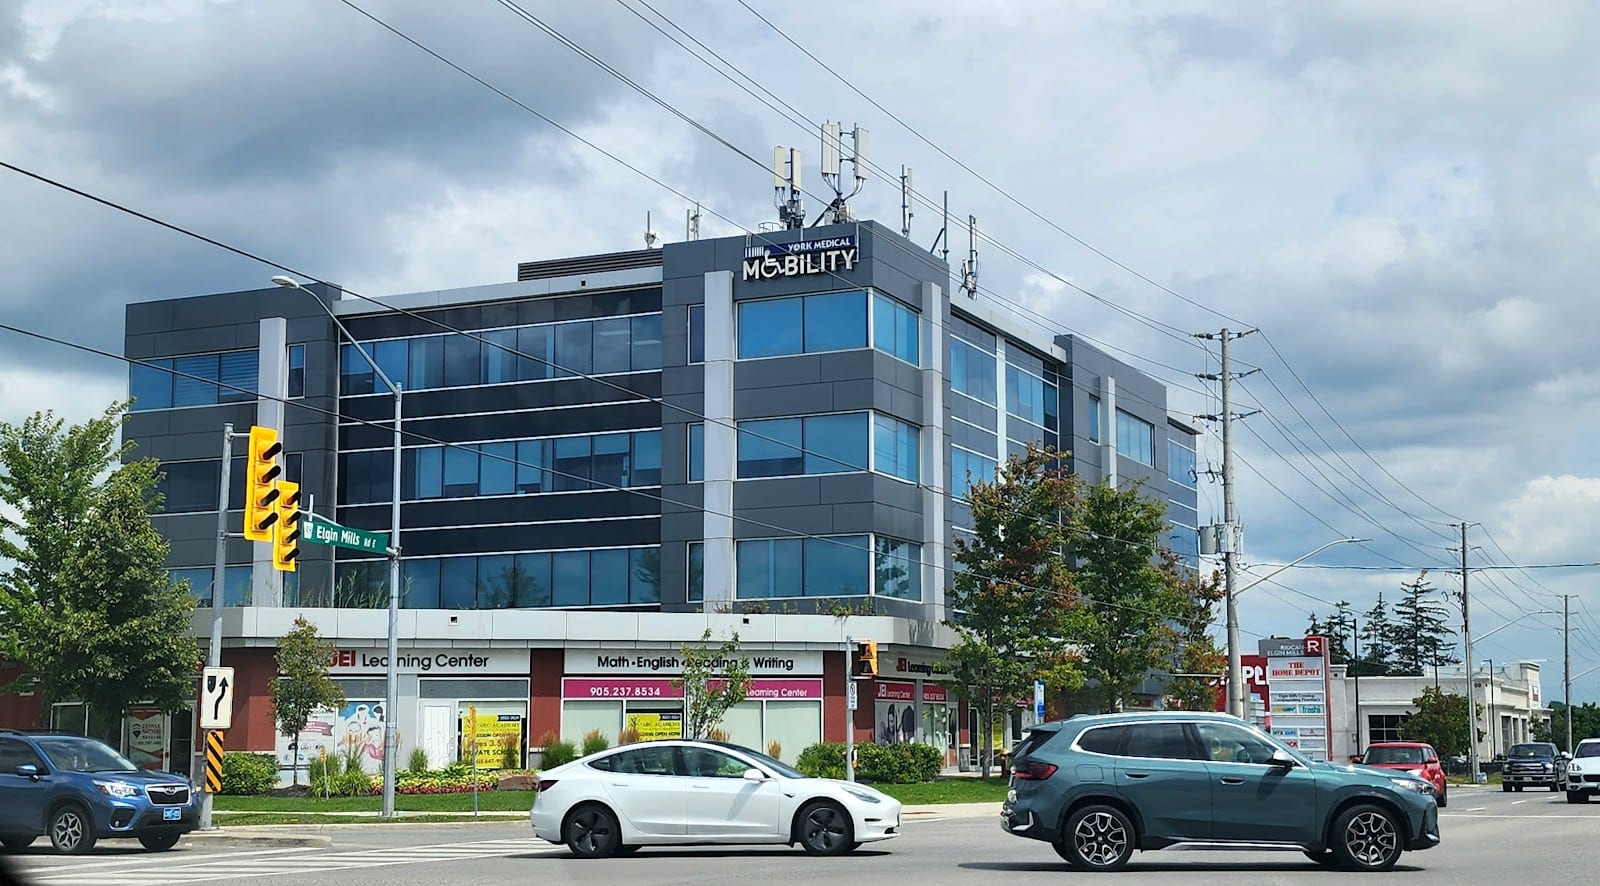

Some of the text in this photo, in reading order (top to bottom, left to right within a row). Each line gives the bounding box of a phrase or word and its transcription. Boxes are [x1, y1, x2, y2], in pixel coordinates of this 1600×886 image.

[788, 237, 851, 252] YORK MEDICAL
[316, 525, 339, 543] Elgin
[340, 530, 361, 546] Mills
[1306, 640, 1320, 653] R
[435, 653, 490, 668] Center
[597, 656, 630, 668] Math
[636, 656, 679, 671] English
[752, 657, 794, 671] Writing
[590, 687, 661, 696] 905.237.8534
[780, 688, 808, 698] Center
